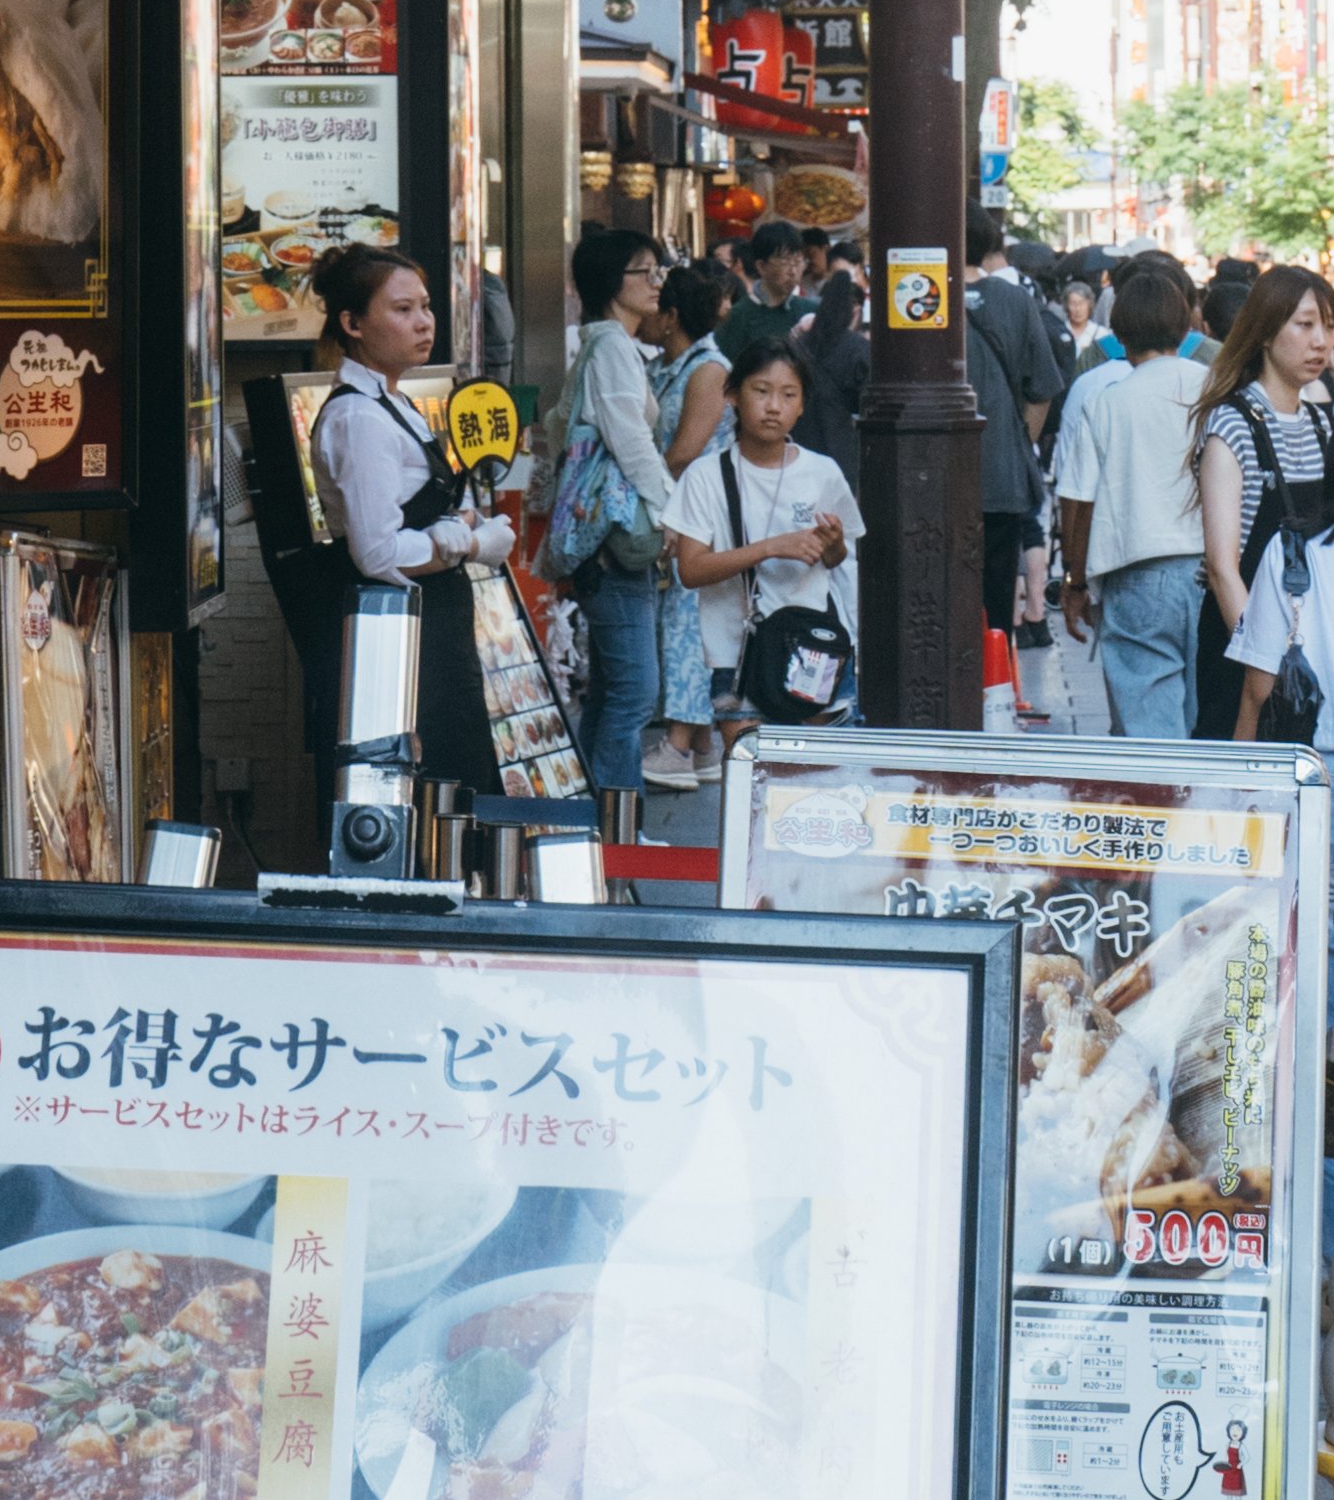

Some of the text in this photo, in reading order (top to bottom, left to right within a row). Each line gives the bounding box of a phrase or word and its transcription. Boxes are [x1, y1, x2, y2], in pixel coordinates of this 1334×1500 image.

[3, 391, 75, 415] 公生和
[458, 406, 512, 449] 熱海
[887, 801, 1168, 840] 食材専門店がこだわり製法で
[928, 832, 1252, 868] 一つ一つおいしく手作りしました
[16, 1002, 796, 1114] お得なサービスセット
[1123, 1209, 1266, 1268] 500円
[270, 1228, 335, 1471] 麻婆豆腐
